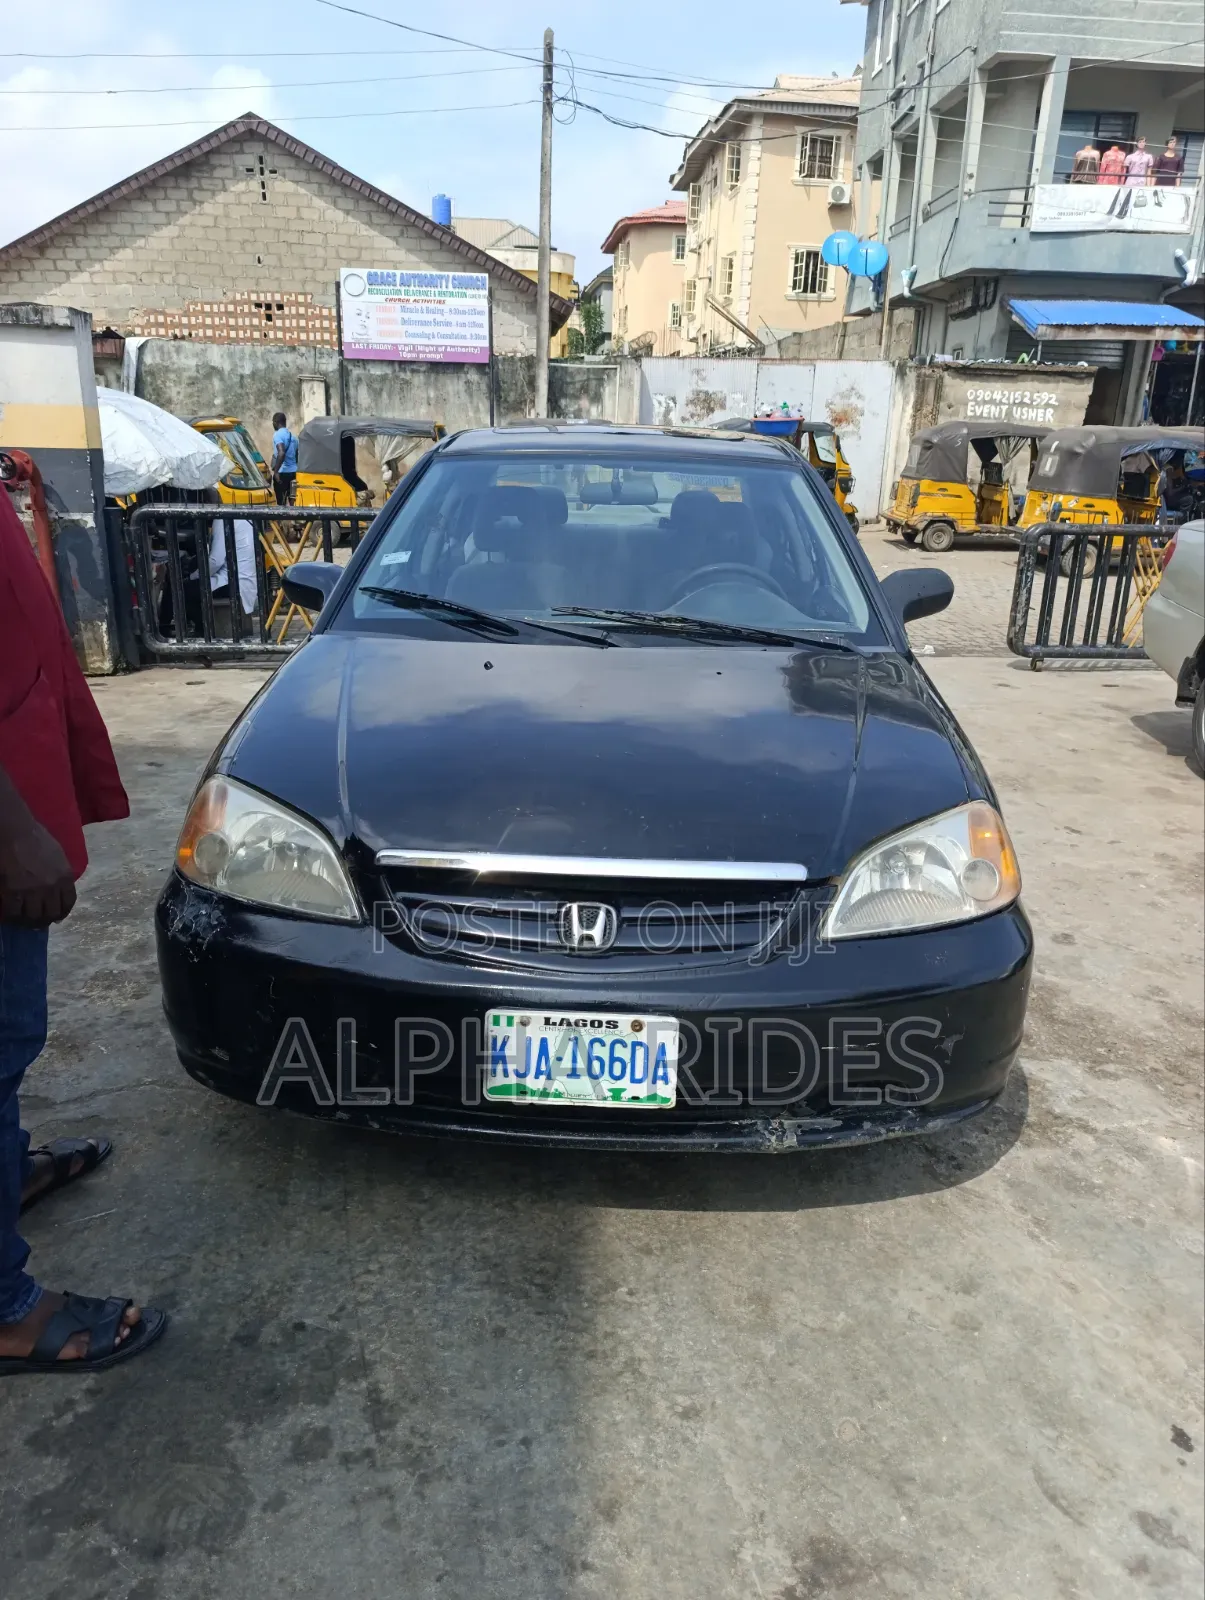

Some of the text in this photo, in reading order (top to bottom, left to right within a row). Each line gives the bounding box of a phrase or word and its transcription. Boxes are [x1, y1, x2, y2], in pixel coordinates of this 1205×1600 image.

[367, 271, 487, 290] GRACE AUTHORITY CHURCH
[367, 287, 402, 296] RECONCILIATION
[404, 289, 433, 297] DELIVERANCE
[437, 290, 468, 299] RESTORATION
[400, 305, 420, 314] Miracle
[420, 306, 424, 314] &
[400, 317, 432, 327] Deliverance
[415, 344, 436, 353] (Night
[447, 346, 481, 354] Authority)
[966, 389, 1059, 406] 09042152592
[966, 402, 1055, 423] EVENT USHER
[543, 1017, 619, 1029] LAGOS
[579, 1028, 624, 1036] EXCELLENCE
[490, 1034, 670, 1085] KJA-166DA
